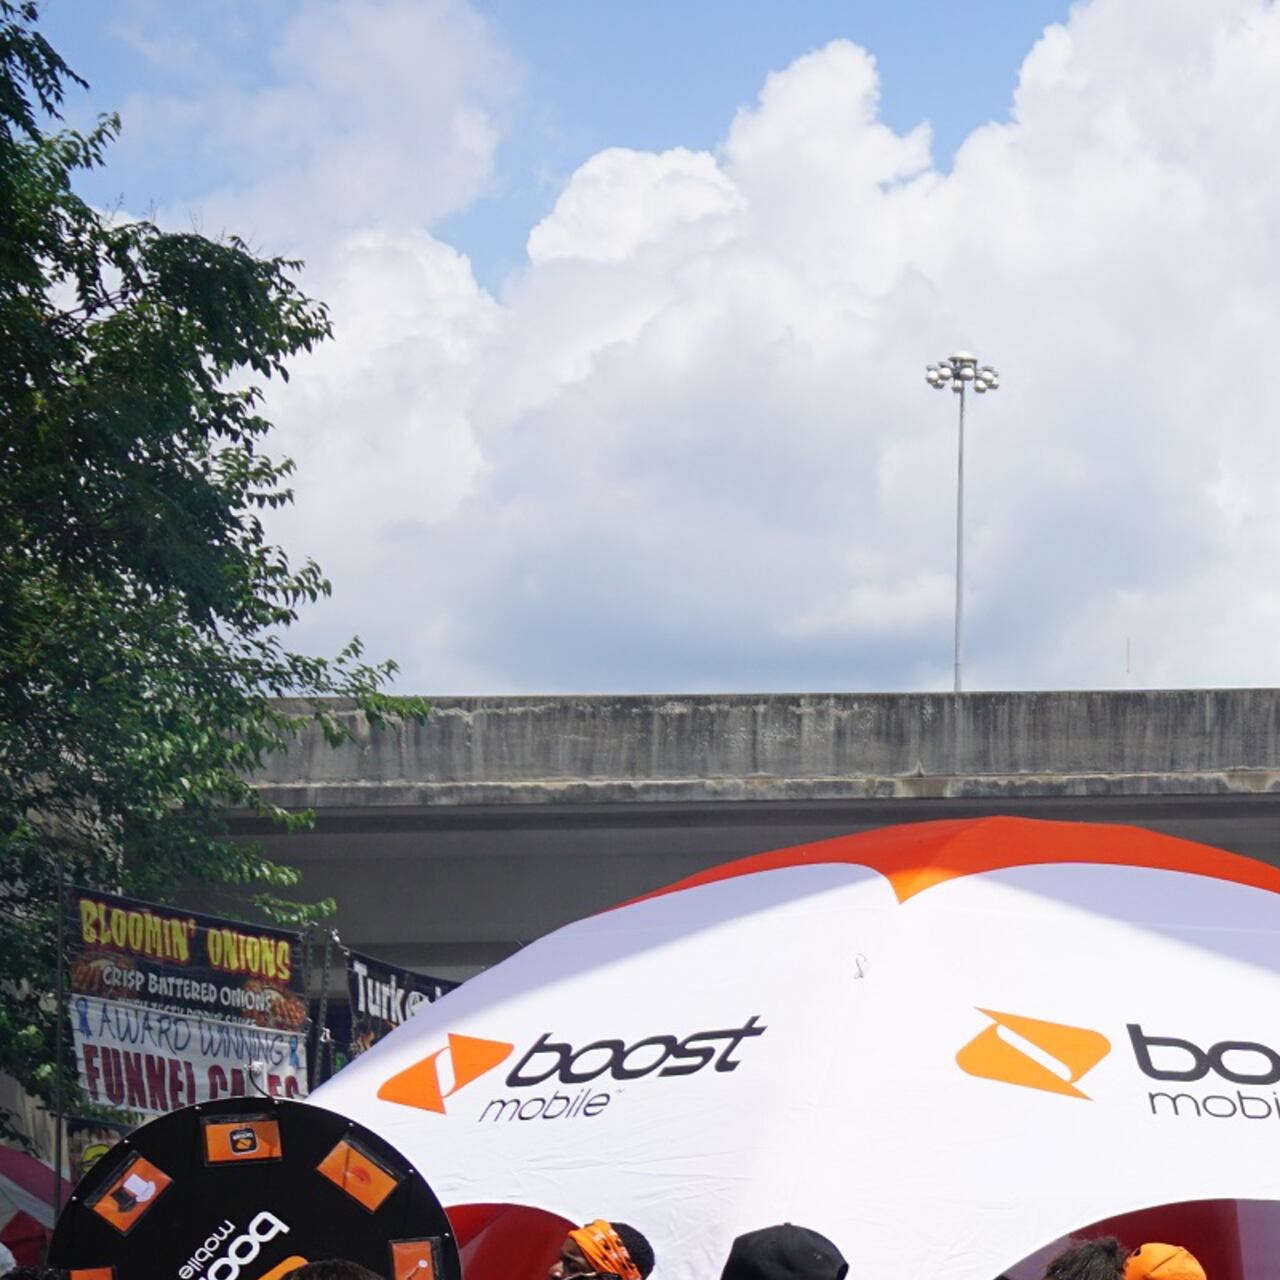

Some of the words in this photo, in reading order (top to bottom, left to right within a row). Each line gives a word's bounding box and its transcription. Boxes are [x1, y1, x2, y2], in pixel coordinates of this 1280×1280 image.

[79, 900, 196, 962] BLOOMIN'
[207, 929, 291, 981] ONIONS
[102, 966, 144, 993] CRISP
[148, 973, 216, 1000] BATTERED
[220, 988, 272, 1012] ONIONS
[99, 1003, 191, 1054] AWARD
[200, 1022, 285, 1066] WINNING
[505, 1014, 768, 1088] boost
[478, 1088, 610, 1123] mobile
[178, 1219, 236, 1280] mobile
